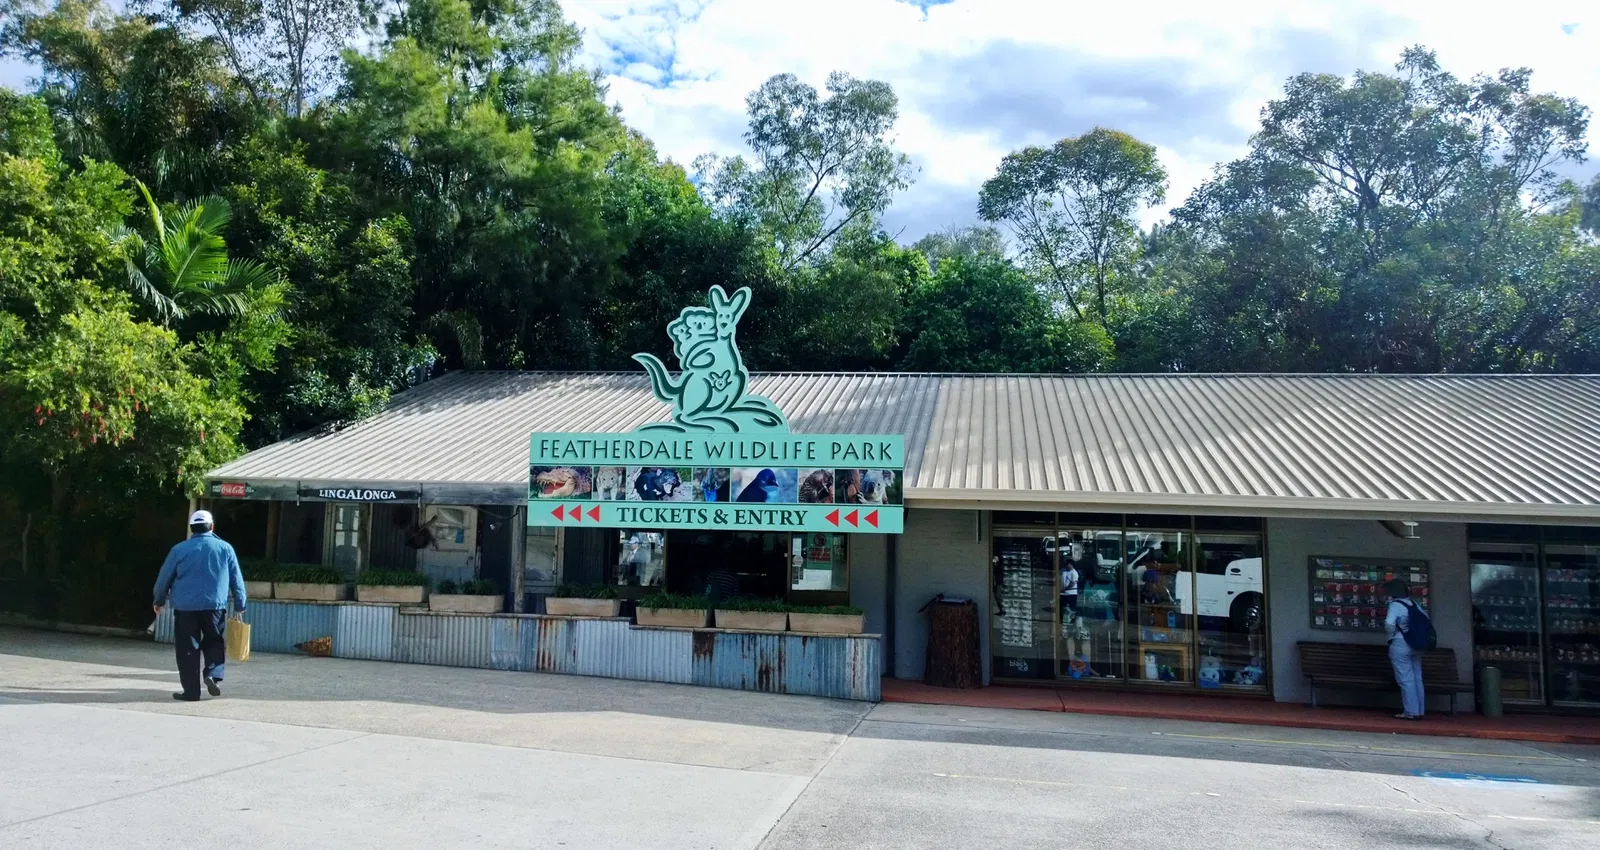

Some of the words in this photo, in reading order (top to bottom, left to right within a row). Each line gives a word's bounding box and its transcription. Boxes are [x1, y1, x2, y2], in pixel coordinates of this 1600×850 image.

[541, 440, 693, 459] FEATHERDALE
[705, 441, 816, 460] WILDLIFE
[832, 442, 893, 460] PARK
[319, 489, 396, 500] LINGALONGA
[617, 507, 708, 525] TICKETS
[712, 508, 729, 525] &
[734, 509, 809, 526] ENTRY
